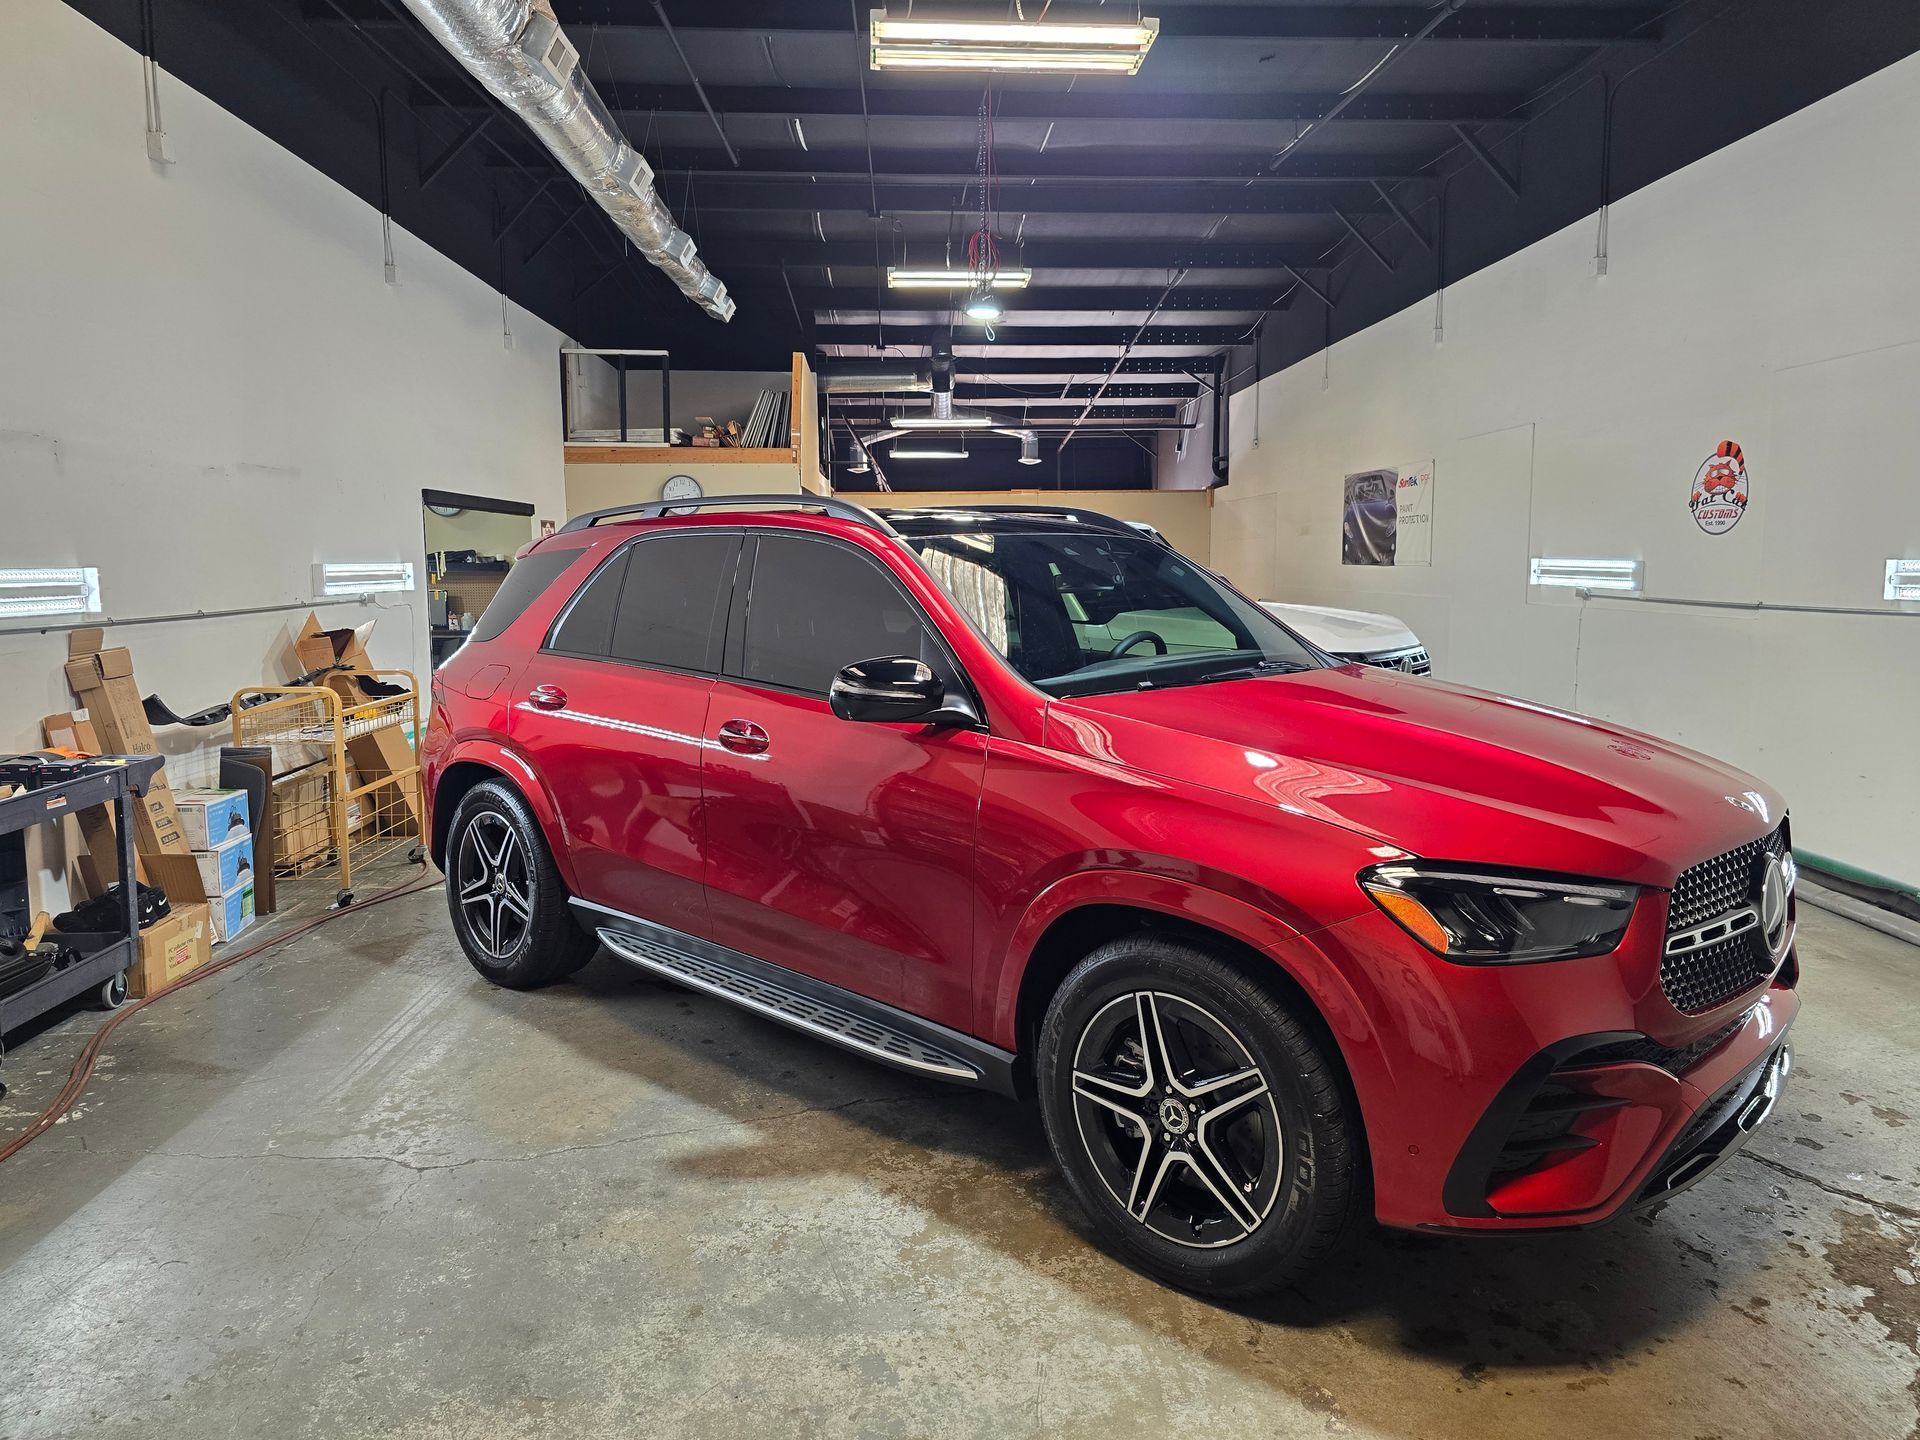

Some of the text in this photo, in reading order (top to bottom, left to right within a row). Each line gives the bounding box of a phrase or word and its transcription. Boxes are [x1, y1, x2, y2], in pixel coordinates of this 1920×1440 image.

[1398, 476, 1418, 488] SunTek
[1399, 504, 1414, 513] PAINT
[1697, 508, 1739, 520] CUSTOMS
[1399, 514, 1429, 524] PROTECTION
